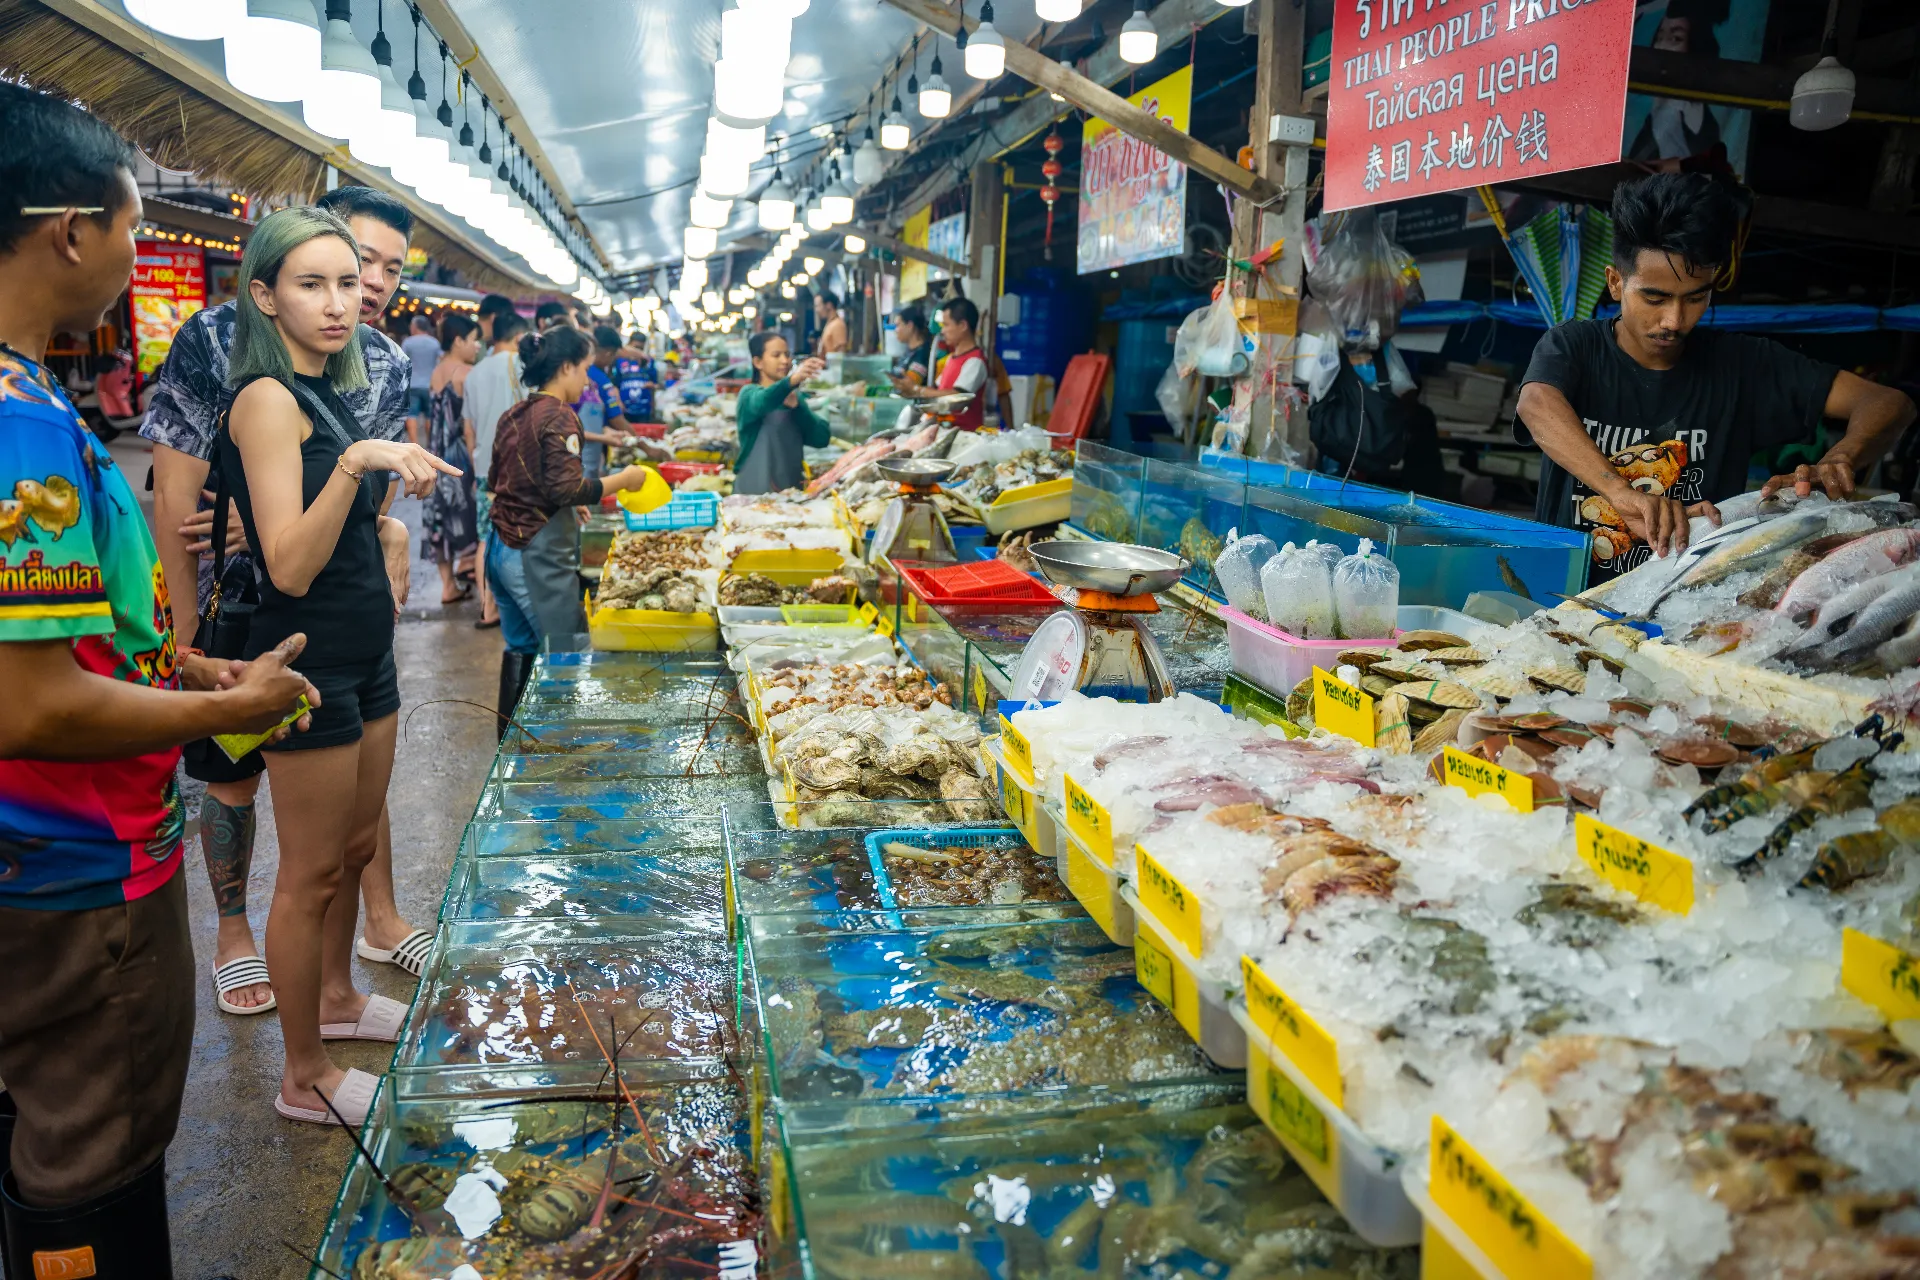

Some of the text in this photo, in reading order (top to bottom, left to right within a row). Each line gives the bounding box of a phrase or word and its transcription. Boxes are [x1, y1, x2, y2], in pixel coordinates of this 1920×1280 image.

[1343, 42, 1393, 89] THAI
[1399, 1, 1498, 70] PEOPLE
[1365, 43, 1559, 131] Тайская цена
[1362, 109, 1549, 193] 泰国本地价钱
